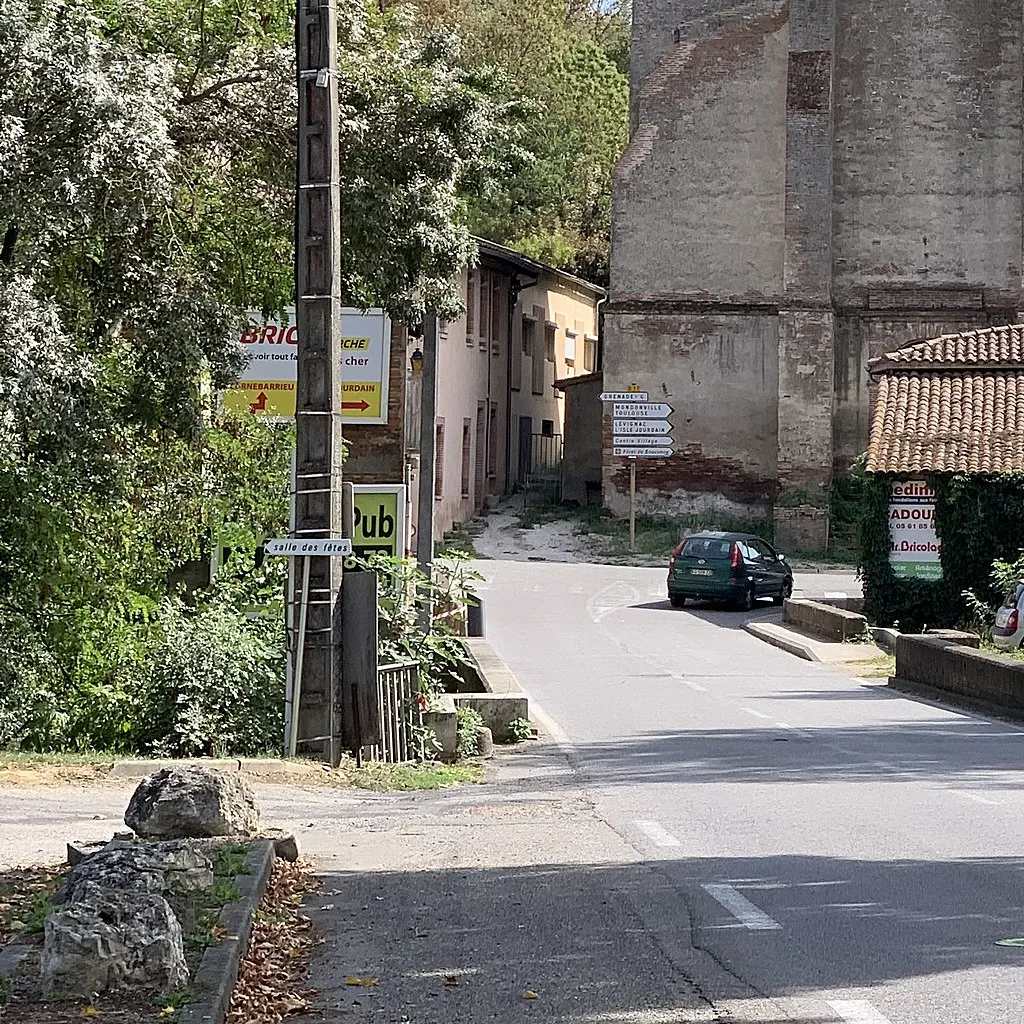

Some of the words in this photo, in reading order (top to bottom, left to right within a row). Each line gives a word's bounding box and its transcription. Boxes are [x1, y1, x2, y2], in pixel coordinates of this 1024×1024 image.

[345, 355, 369, 365] cher
[232, 382, 294, 391] ORNEBARRIEU
[273, 543, 297, 551] salle
[301, 543, 319, 551] des
